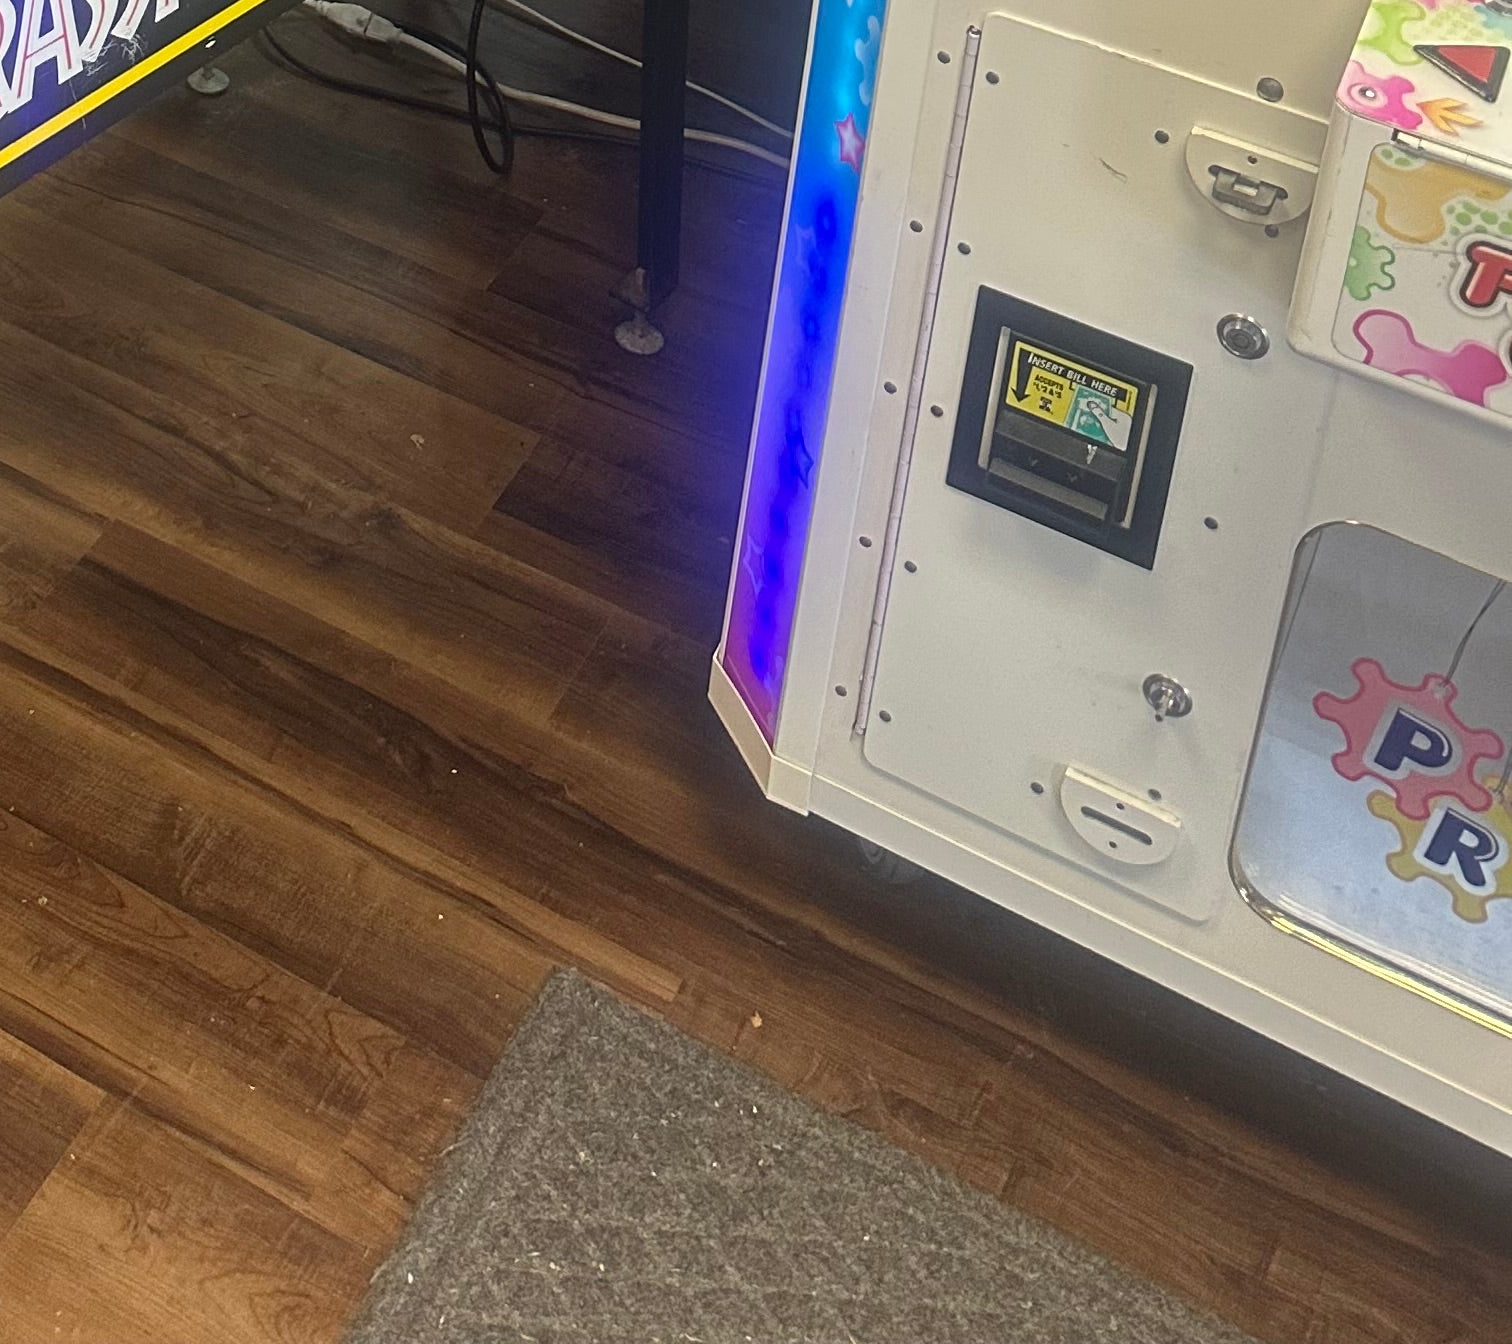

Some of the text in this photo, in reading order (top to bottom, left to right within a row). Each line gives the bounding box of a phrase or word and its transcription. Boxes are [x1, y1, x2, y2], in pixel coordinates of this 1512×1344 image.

[1028, 352, 1118, 397] INSERT BILL HERE
